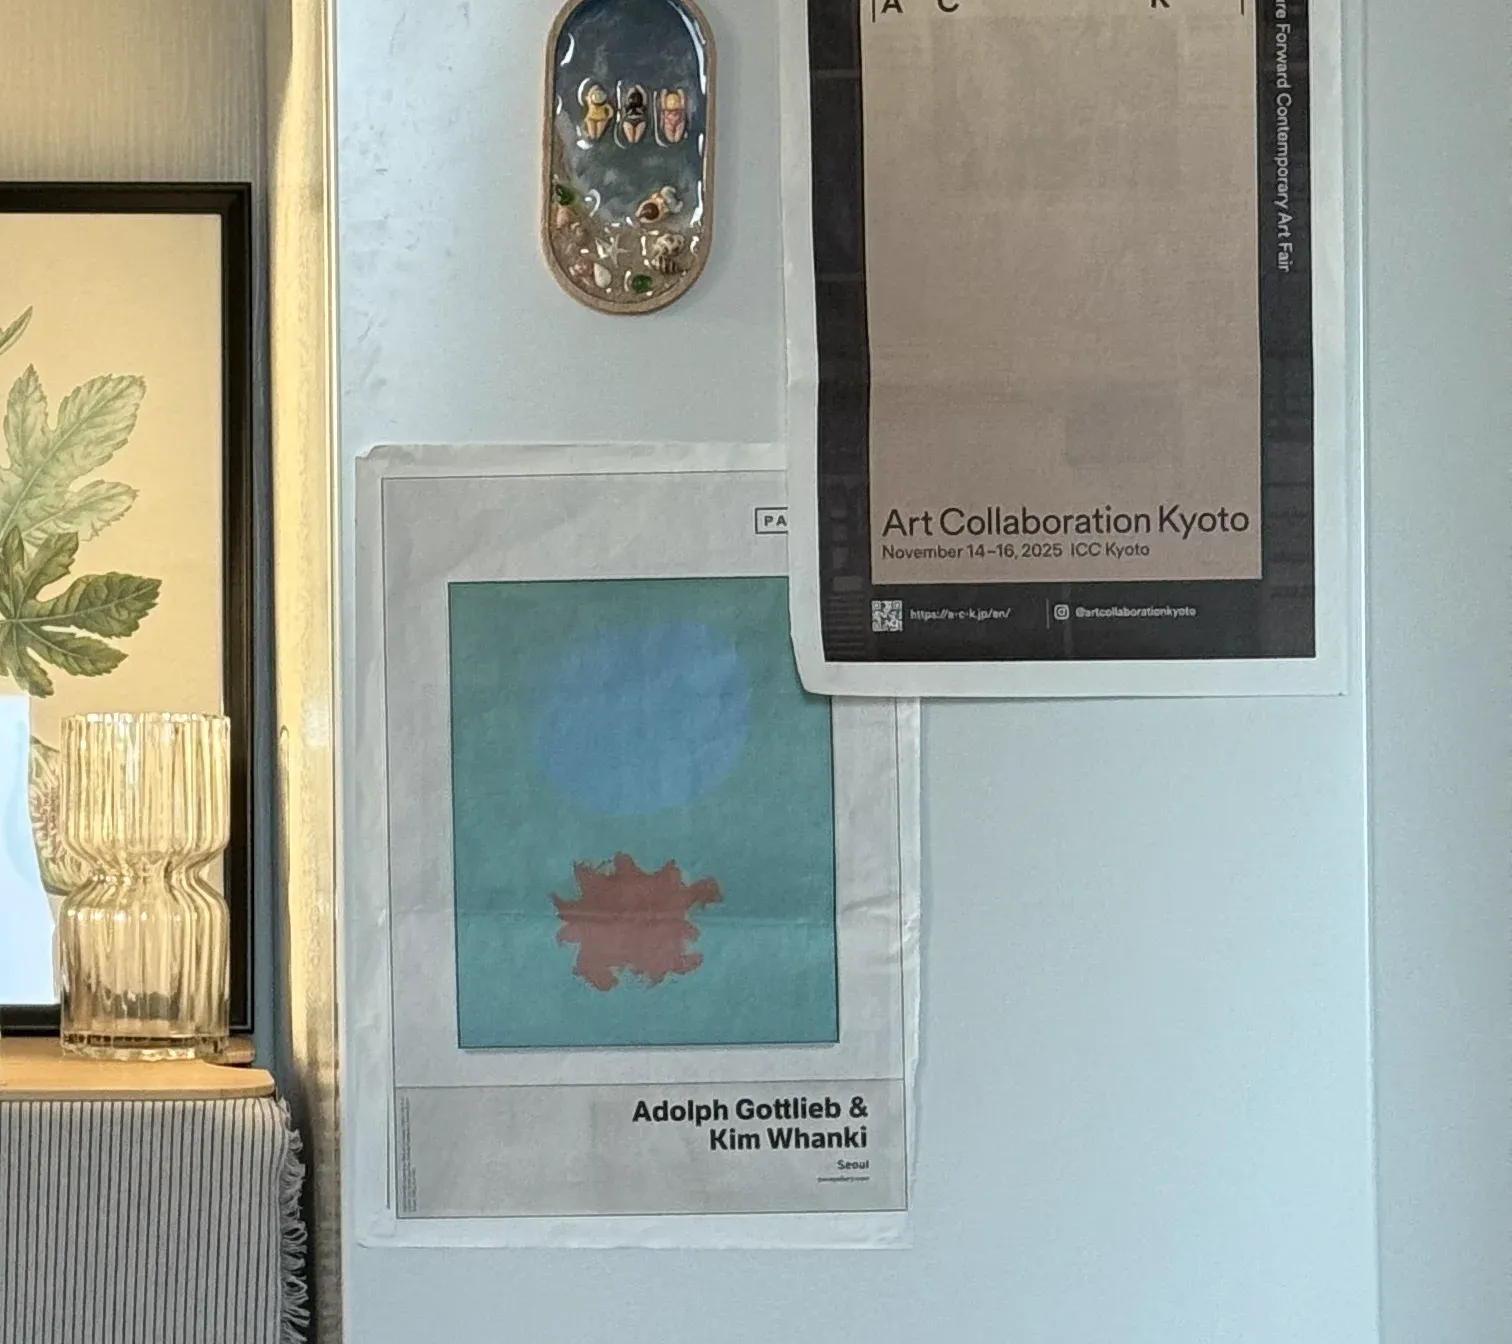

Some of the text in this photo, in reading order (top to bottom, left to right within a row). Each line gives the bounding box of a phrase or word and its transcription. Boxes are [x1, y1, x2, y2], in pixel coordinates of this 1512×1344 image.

[1274, 24, 1291, 89] Forward
[1274, 93, 1292, 210] Contemporary
[1276, 213, 1293, 239] Art
[1277, 242, 1293, 272] Fair
[883, 504, 1249, 542] Art Collaboration Kyoto
[882, 543, 963, 560] November
[1021, 543, 1063, 560] 2025
[1071, 543, 1103, 559] ICC
[1105, 542, 1150, 563] Kyoto
[632, 1096, 869, 1126] Adolph Gottlieb &
[710, 1125, 867, 1151] Kim Whanki
[837, 1159, 869, 1171] Seoul
